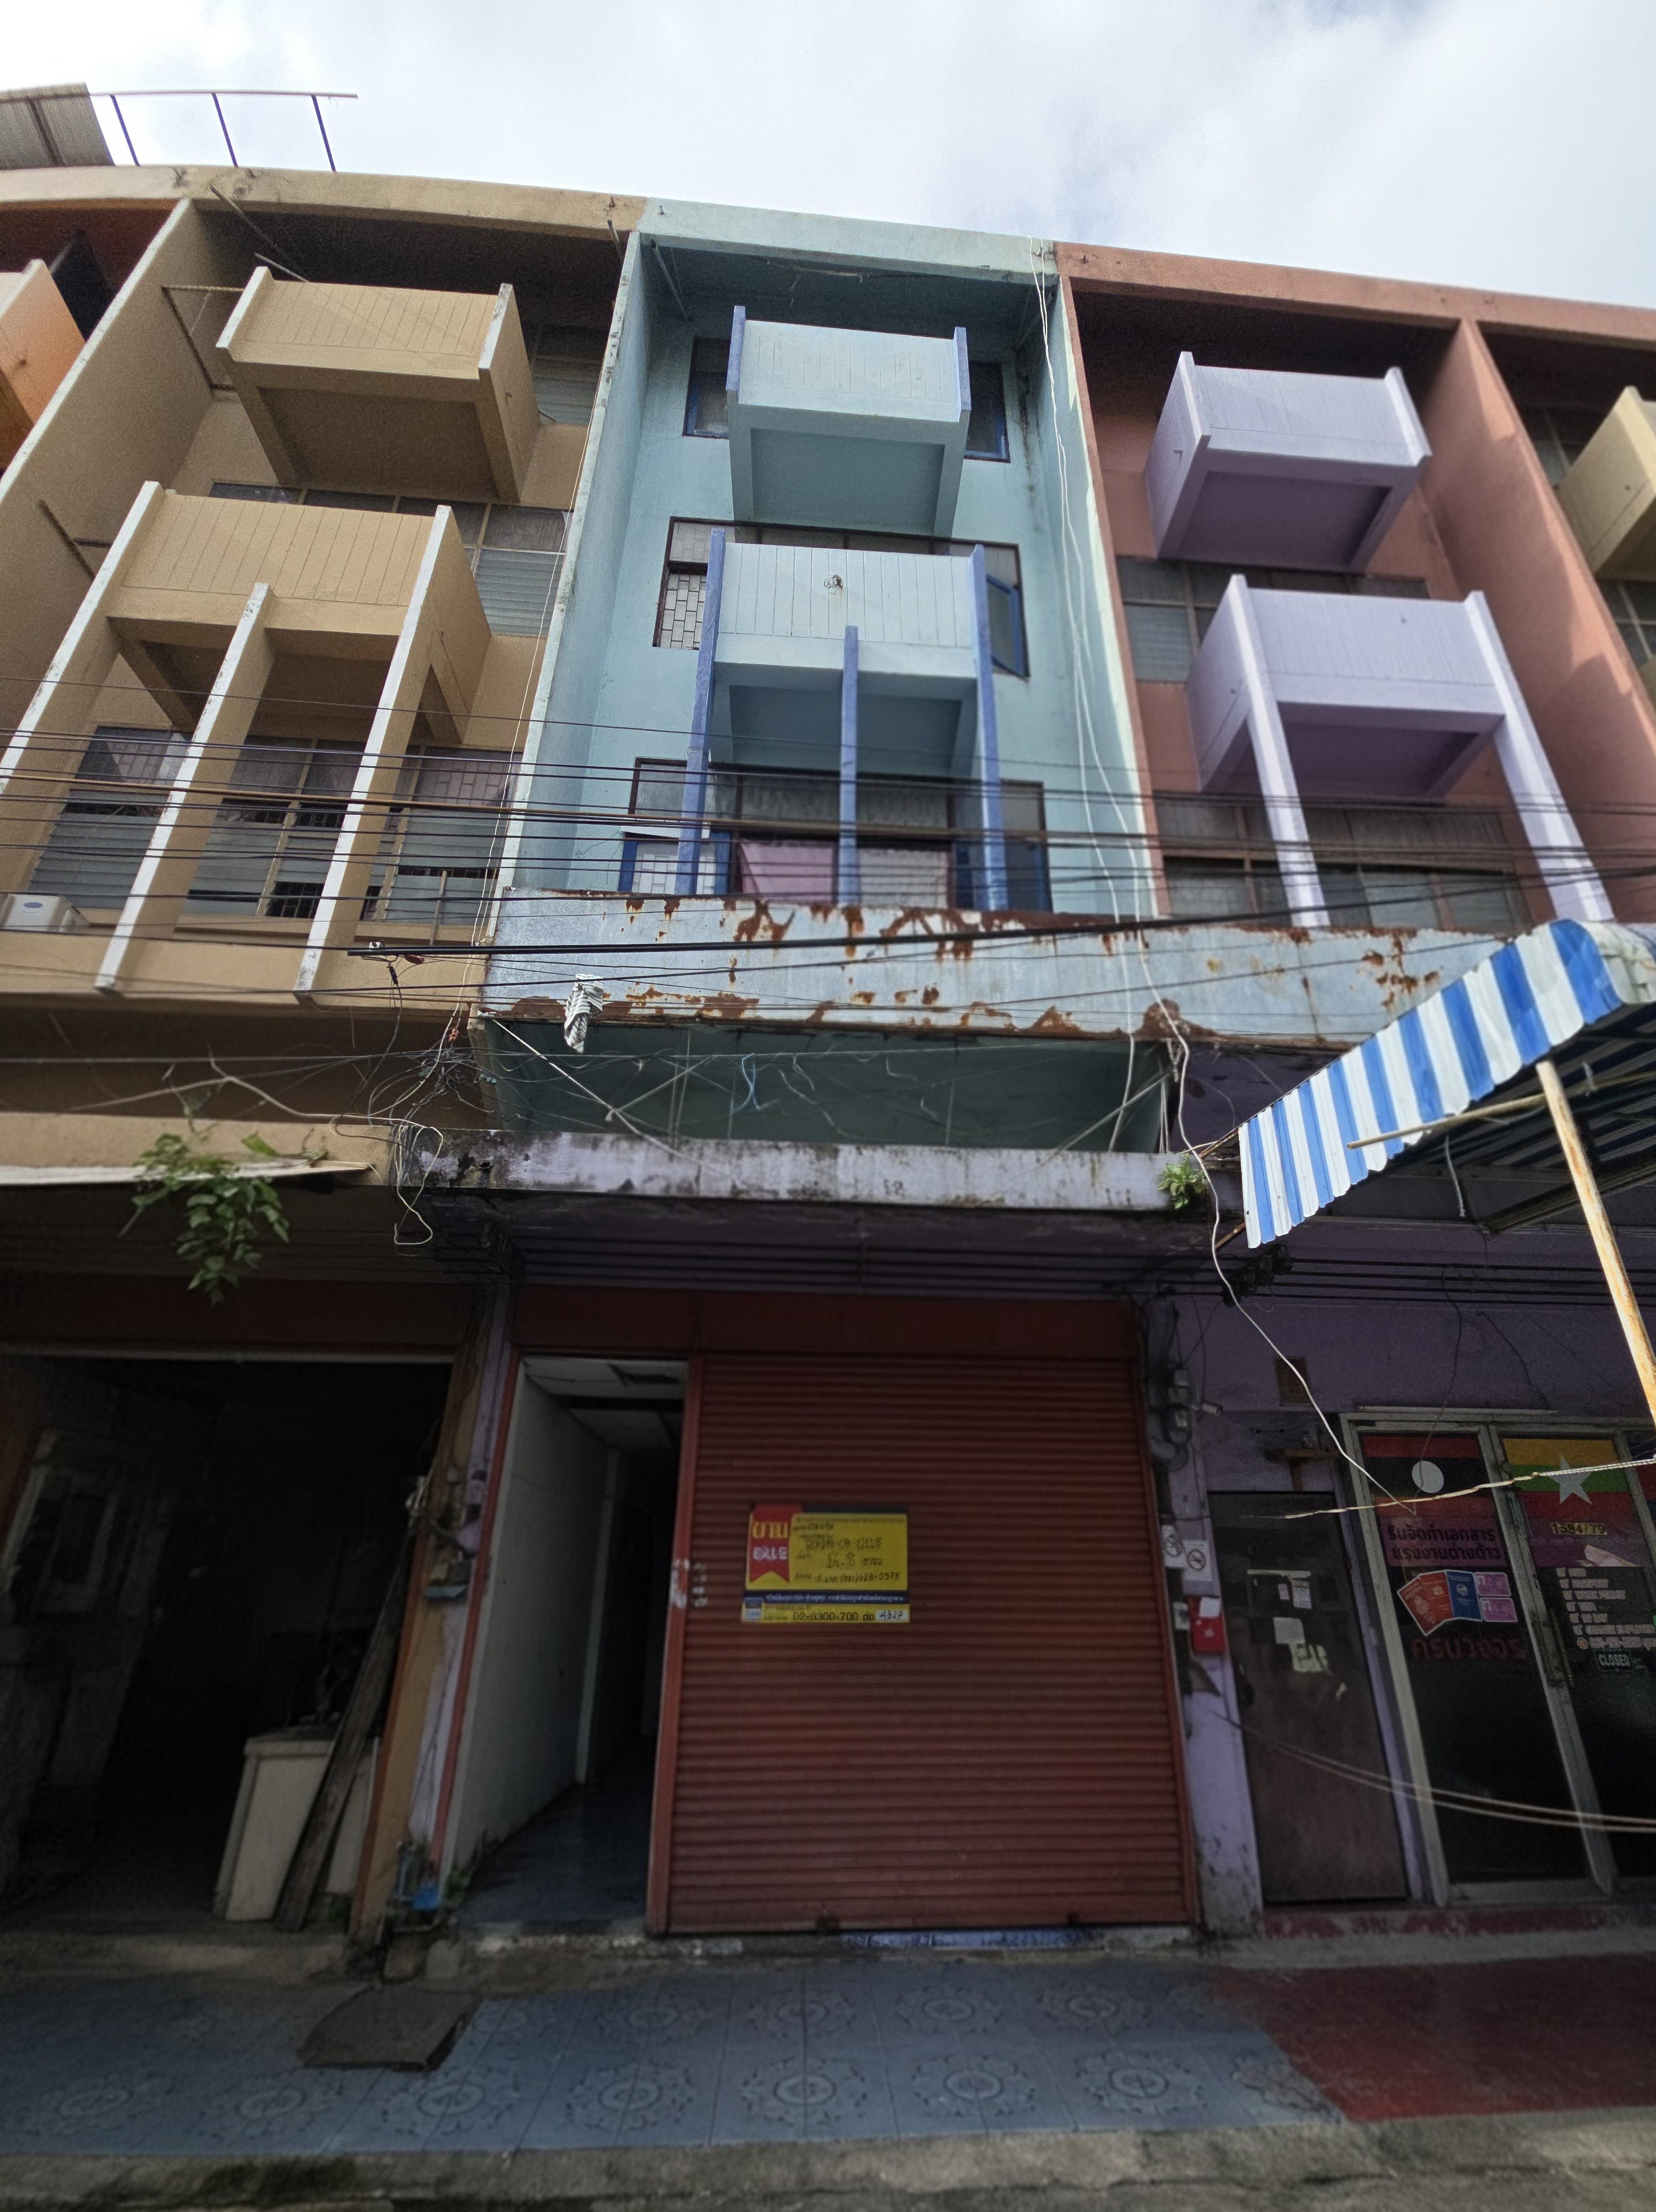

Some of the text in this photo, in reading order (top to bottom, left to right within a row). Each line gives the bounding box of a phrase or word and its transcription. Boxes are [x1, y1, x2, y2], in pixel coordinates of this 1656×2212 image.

[753, 1521, 788, 1539] ขาย
[1388, 1522, 1496, 1541] รับจัดทำเอกสาร
[753, 1546, 788, 1560] SALE
[1392, 1543, 1501, 1561] แรงงานต่างด้าว
[793, 1611, 858, 1621] 02-6300-700
[862, 1610, 875, 1621] ต่อ
[1598, 1653, 1631, 1667] CLOSED
